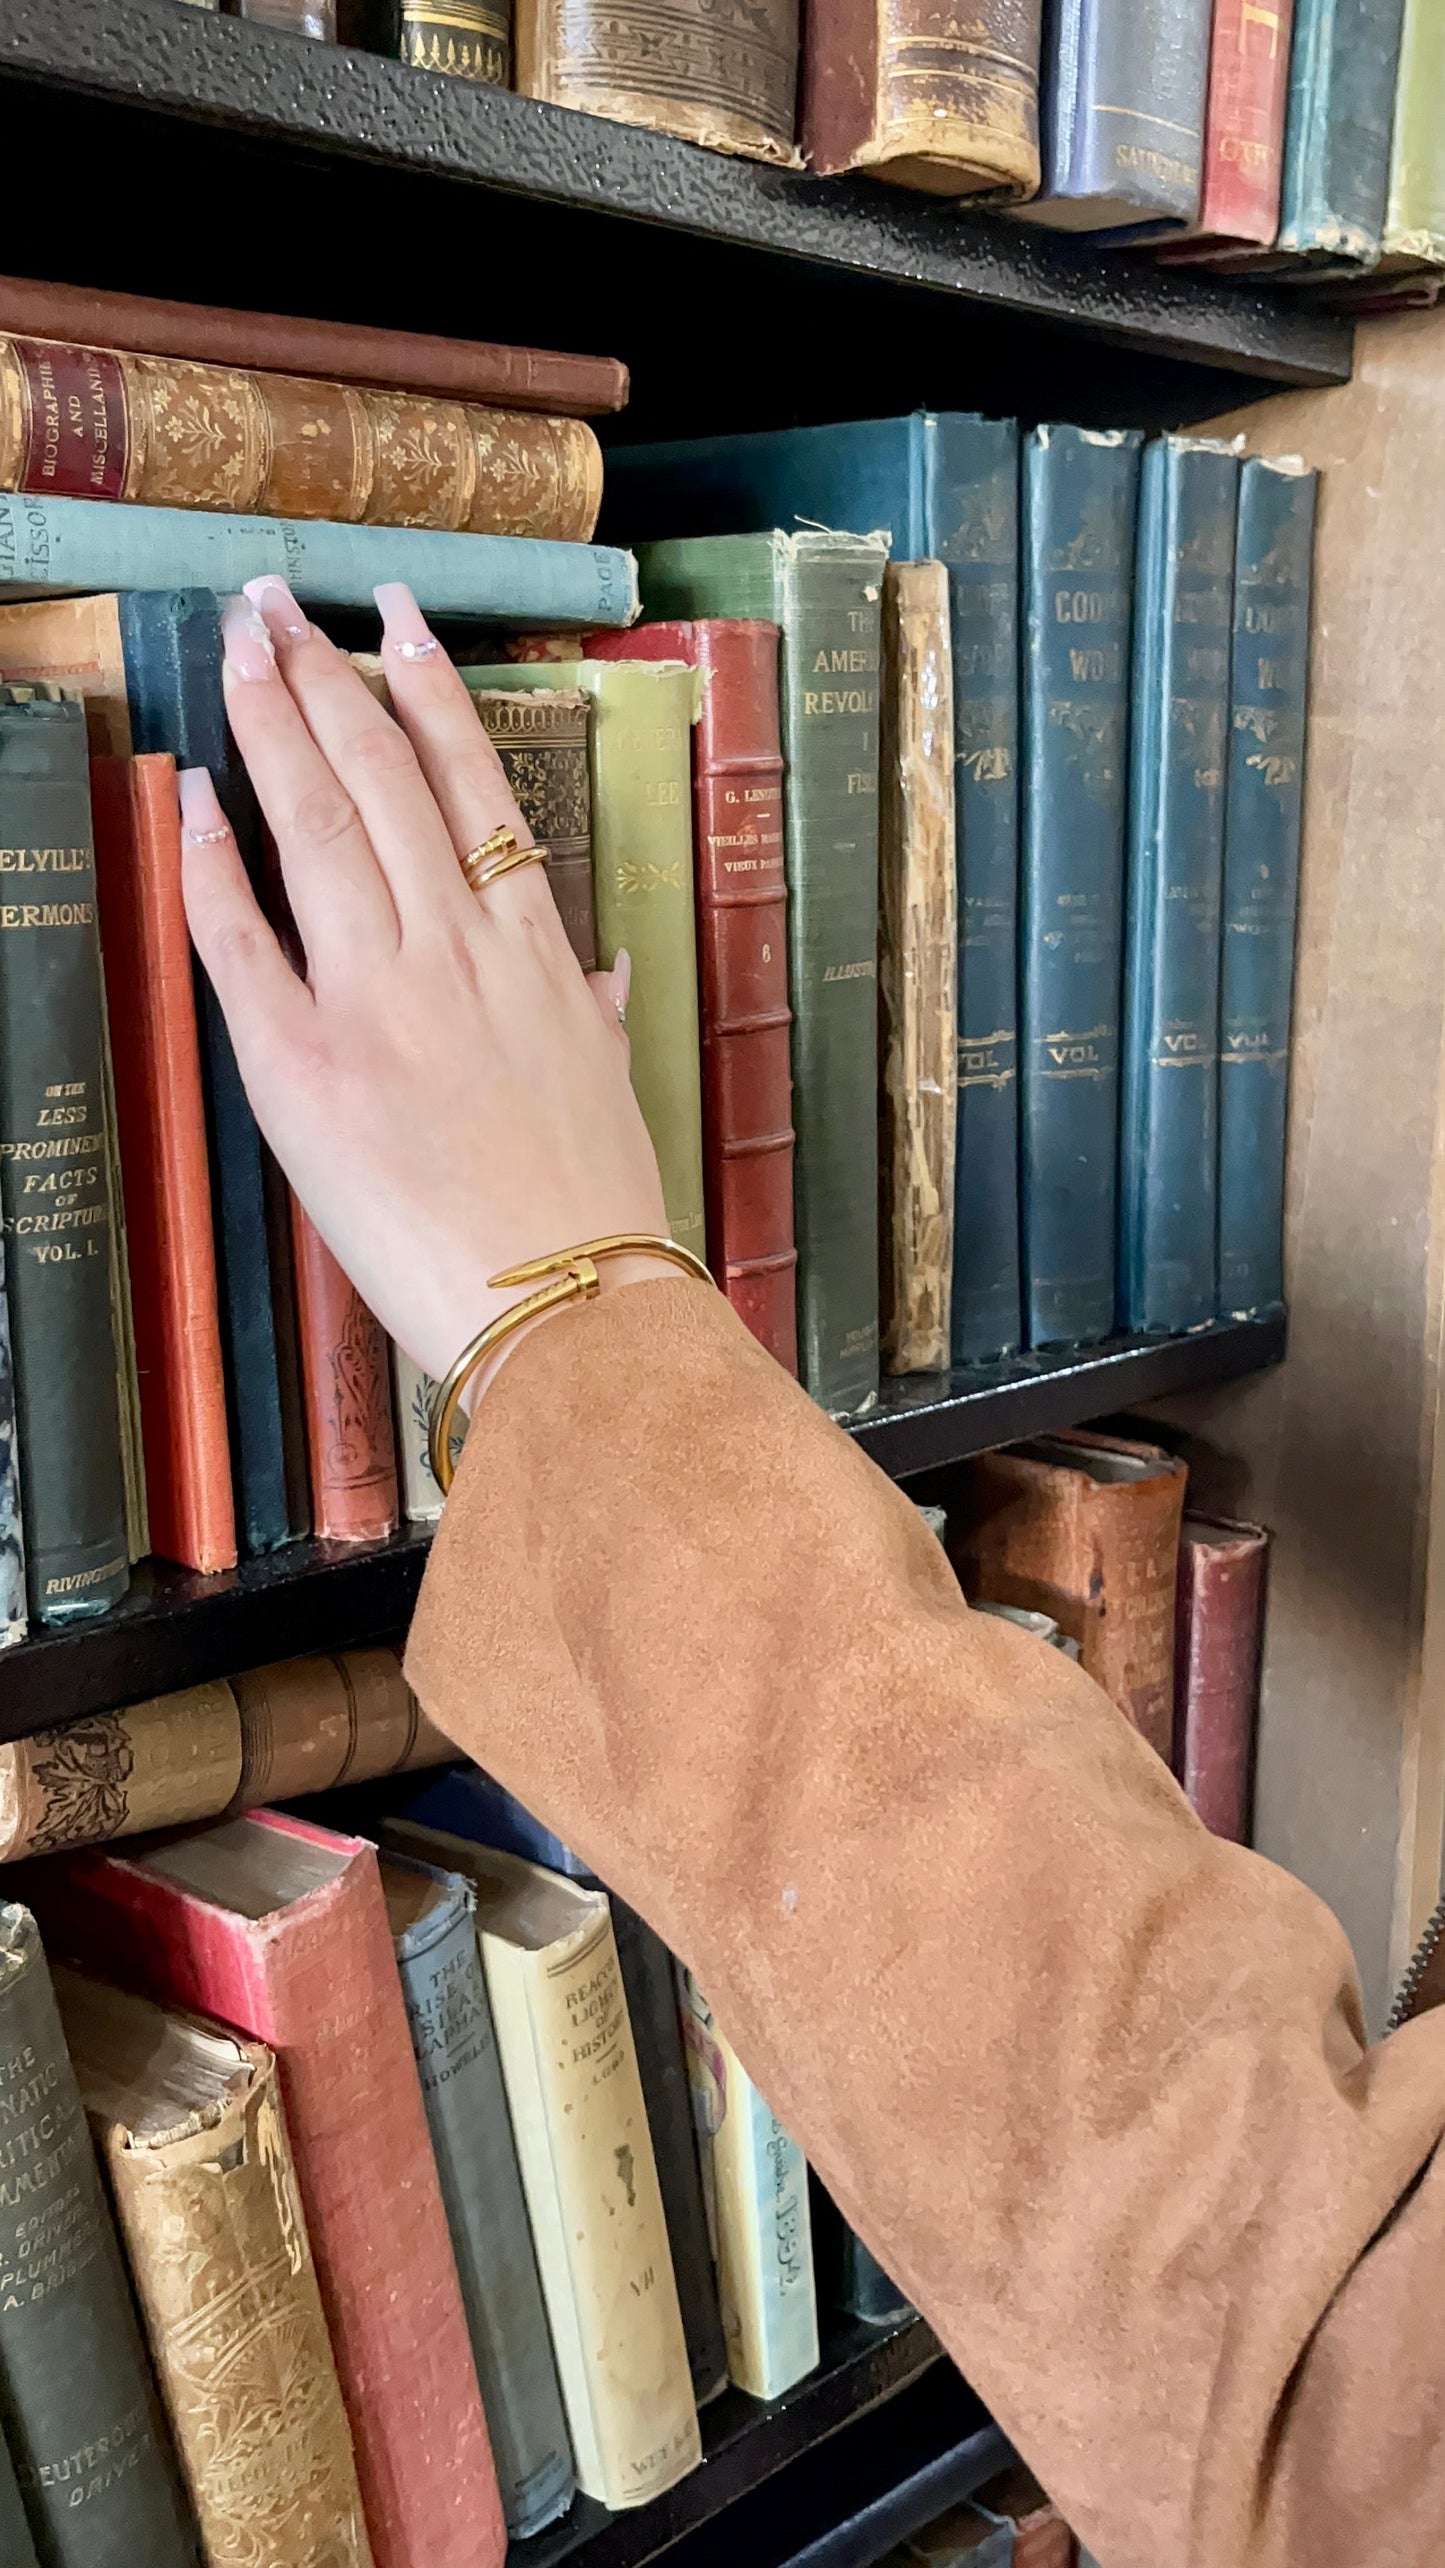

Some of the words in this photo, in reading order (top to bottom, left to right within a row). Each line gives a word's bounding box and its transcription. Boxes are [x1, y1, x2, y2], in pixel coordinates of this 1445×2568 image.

[67, 395, 84, 438] AND
[724, 790, 741, 804] G.
[36, 1105, 88, 1127] LESS
[22, 1166, 98, 1193] FACTS
[54, 1193, 79, 1207] OF
